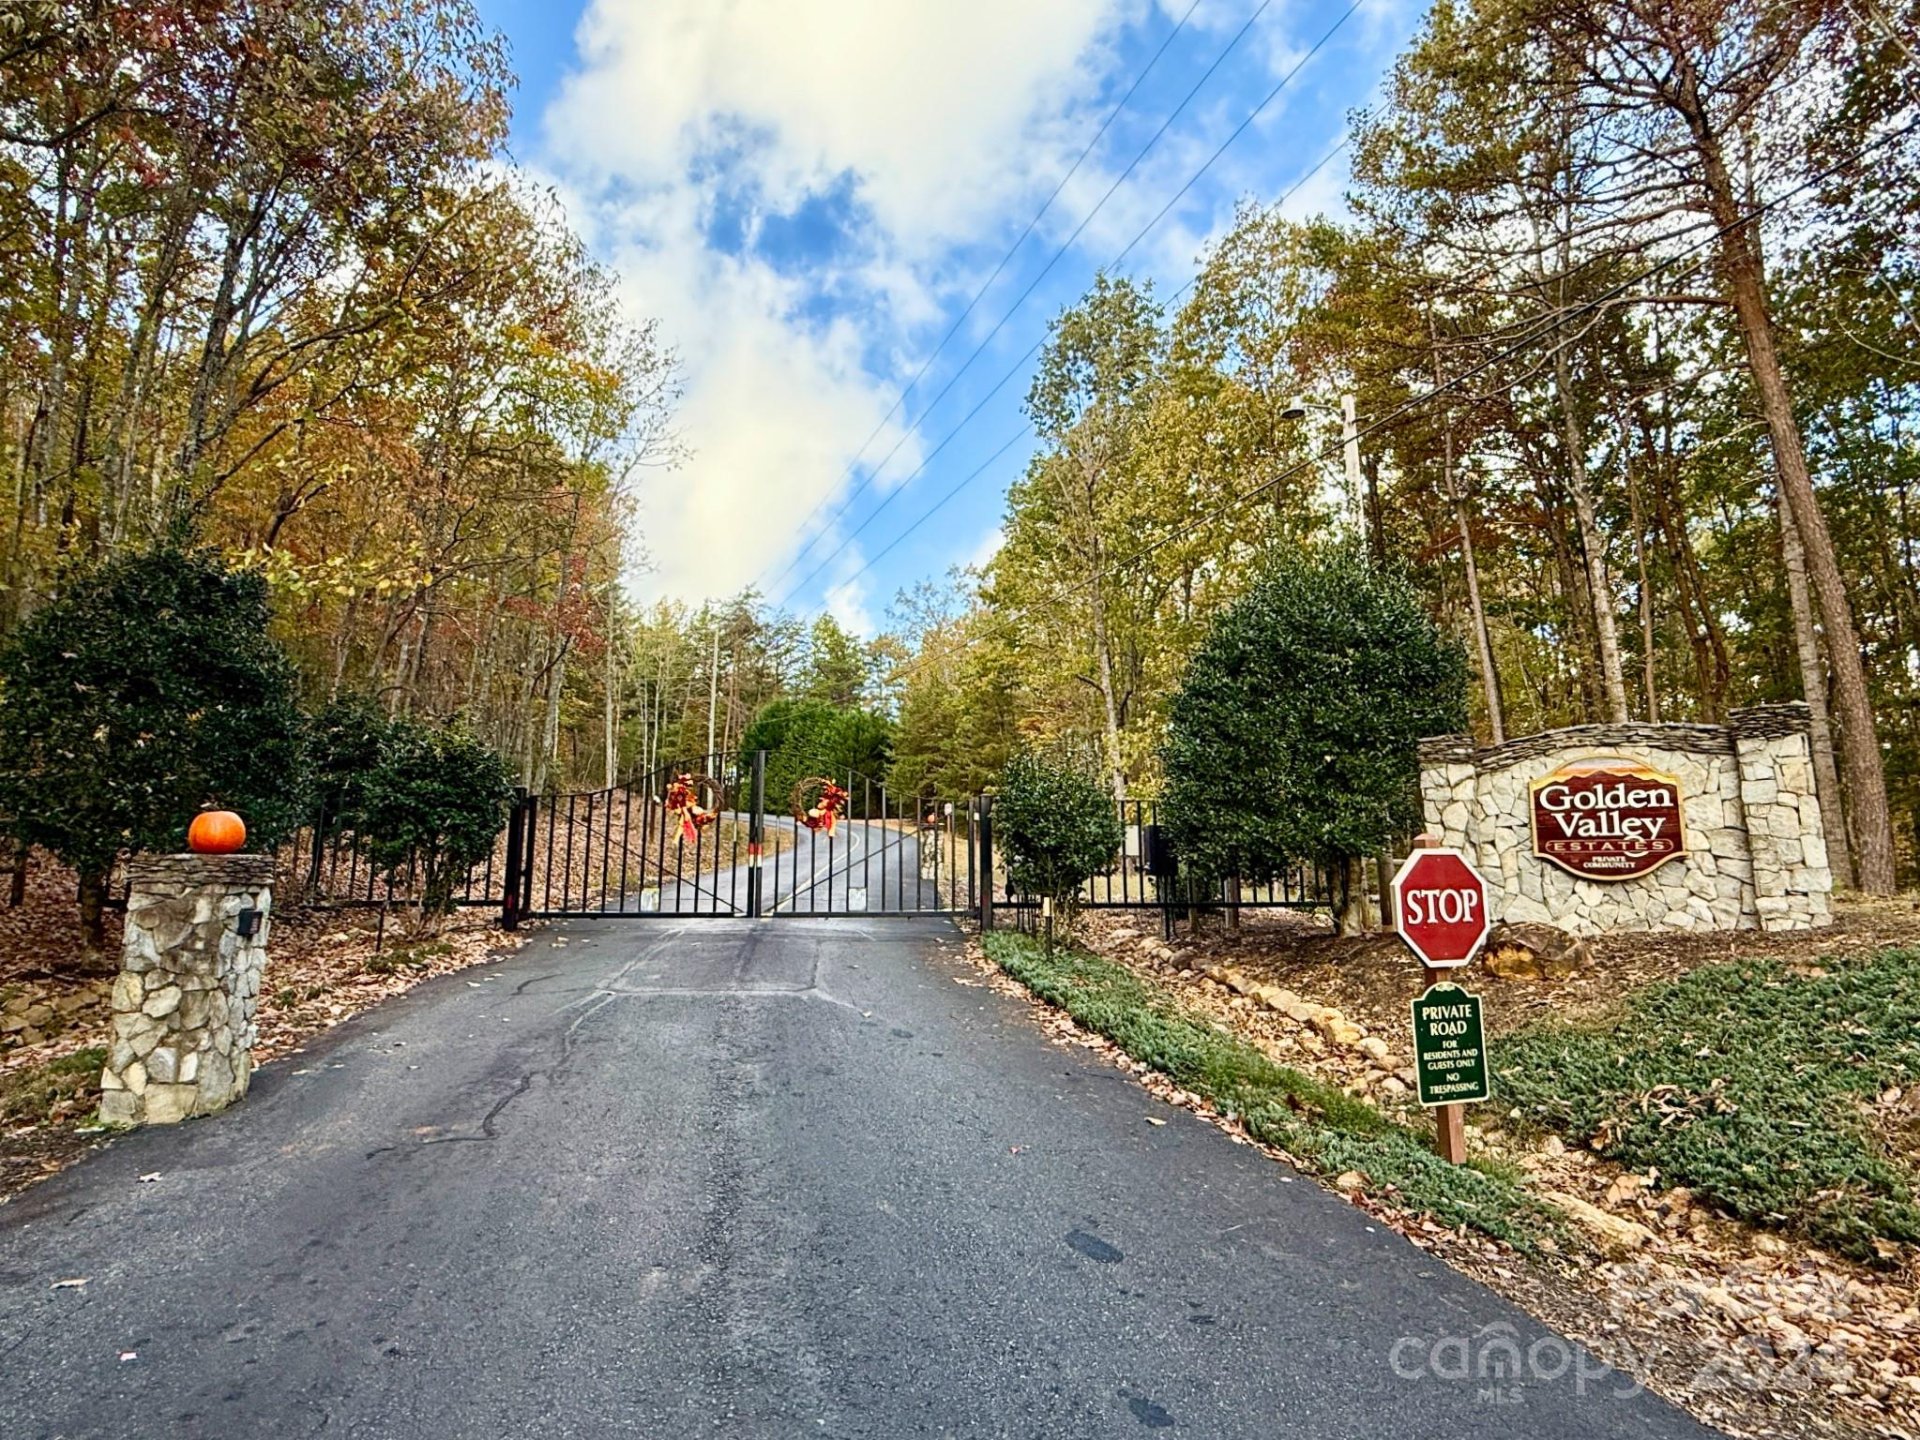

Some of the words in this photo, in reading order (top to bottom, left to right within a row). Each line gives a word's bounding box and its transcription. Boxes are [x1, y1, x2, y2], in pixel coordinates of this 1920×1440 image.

[1539, 783, 1674, 810] Golden
[1551, 810, 1666, 857] Valley
[1554, 841, 1665, 851] ESTATES
[1406, 888, 1478, 925] STOP
[1422, 1004, 1472, 1020] PRIVATE
[1430, 1020, 1467, 1036] ROAD
[1442, 1040, 1458, 1049] FOR
[1423, 1050, 1461, 1060] RESIDENTS
[1462, 1048, 1479, 1057] AND
[1427, 1060, 1454, 1071] GUESTS
[1456, 1058, 1476, 1068] ONLY
[1446, 1072, 1460, 1082] NO
[1429, 1082, 1479, 1095] TRESPASSING
